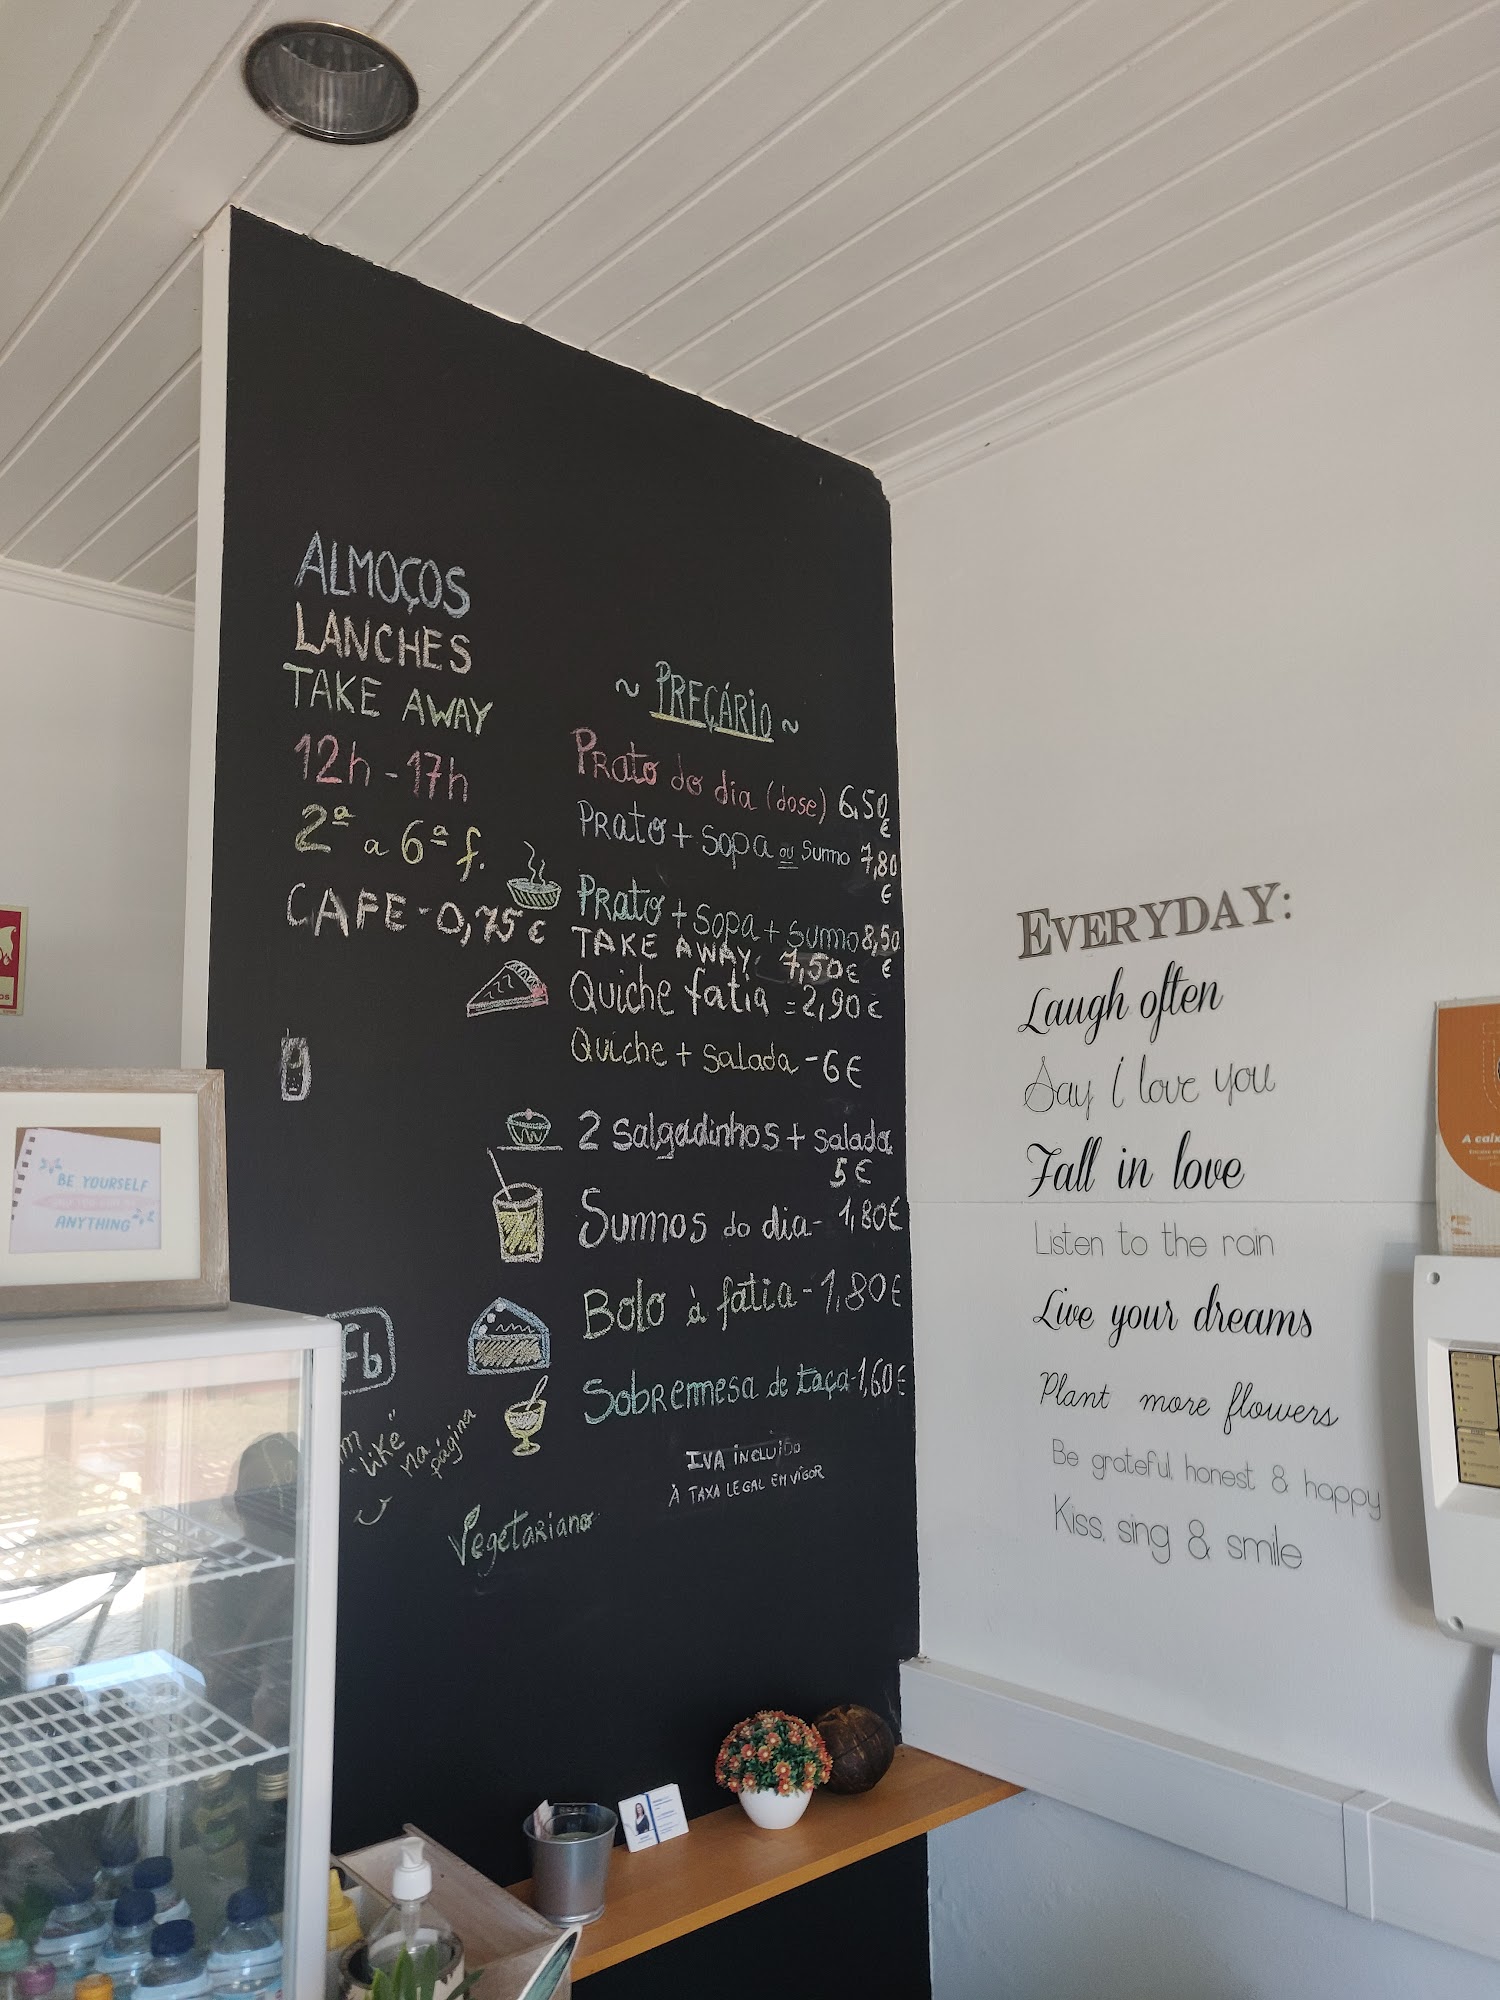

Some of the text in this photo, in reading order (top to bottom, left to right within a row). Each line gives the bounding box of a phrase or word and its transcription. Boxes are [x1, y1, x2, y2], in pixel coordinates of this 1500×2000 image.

[294, 531, 470, 618] ALMOÇOS
[295, 602, 471, 673] LANCHES
[283, 663, 493, 736] TAKE AWAY
[294, 734, 370, 786] 12h
[406, 750, 468, 801] 17h
[571, 727, 888, 824] Prato do dia (dose) 6,50
[364, 839, 389, 857] a
[577, 800, 667, 846] Prato
[672, 822, 694, 848] +
[779, 846, 794, 859] ou
[860, 842, 897, 881] 7,80
[577, 874, 665, 926] Prato
[671, 899, 688, 929] +
[764, 920, 780, 943] +
[861, 924, 900, 957] 8,50
[571, 926, 657, 958] TAKE
[676, 938, 752, 973] AWAY
[570, 963, 674, 1016] Quiche
[684, 967, 769, 1017] fatia
[1018, 960, 1224, 1045] Laugh often
[571, 1027, 668, 1067] Quiche
[676, 1042, 692, 1067] +
[1024, 1056, 1094, 1120] Say
[1139, 1054, 1200, 1104] love
[1215, 1063, 1276, 1106] you
[578, 1109, 600, 1151] 2
[787, 1123, 805, 1151] +
[57, 1173, 149, 1193] BE YOURSELF
[1026, 1130, 1245, 1198] Fall in love
[54, 1215, 131, 1233] ANYTHING
[578, 1187, 706, 1249] Sumos
[723, 1210, 750, 1238] do
[839, 1196, 903, 1233] 1,80€
[1034, 1220, 1275, 1257] Listen to the rain
[582, 1278, 666, 1340] Bolo
[685, 1284, 709, 1327] à
[716, 1272, 797, 1331] fatia
[821, 1268, 902, 1315] 1,80€
[1033, 1283, 1313, 1348] Live your dreams
[582, 1369, 759, 1425] Sobremesa
[766, 1366, 788, 1399] de
[1040, 1371, 1339, 1435] Plant more flowers
[686, 1450, 725, 1471] IVA
[688, 1484, 720, 1504] TAXA
[727, 1479, 765, 1497] LEGAL
[1052, 1438, 1079, 1467] Be
[1185, 1453, 1256, 1490] honest
[1272, 1465, 1288, 1493] &
[1304, 1469, 1381, 1521] happy
[1118, 1514, 1171, 1564] sing
[1187, 1519, 1210, 1559] &
[1227, 1525, 1303, 1569] smile
